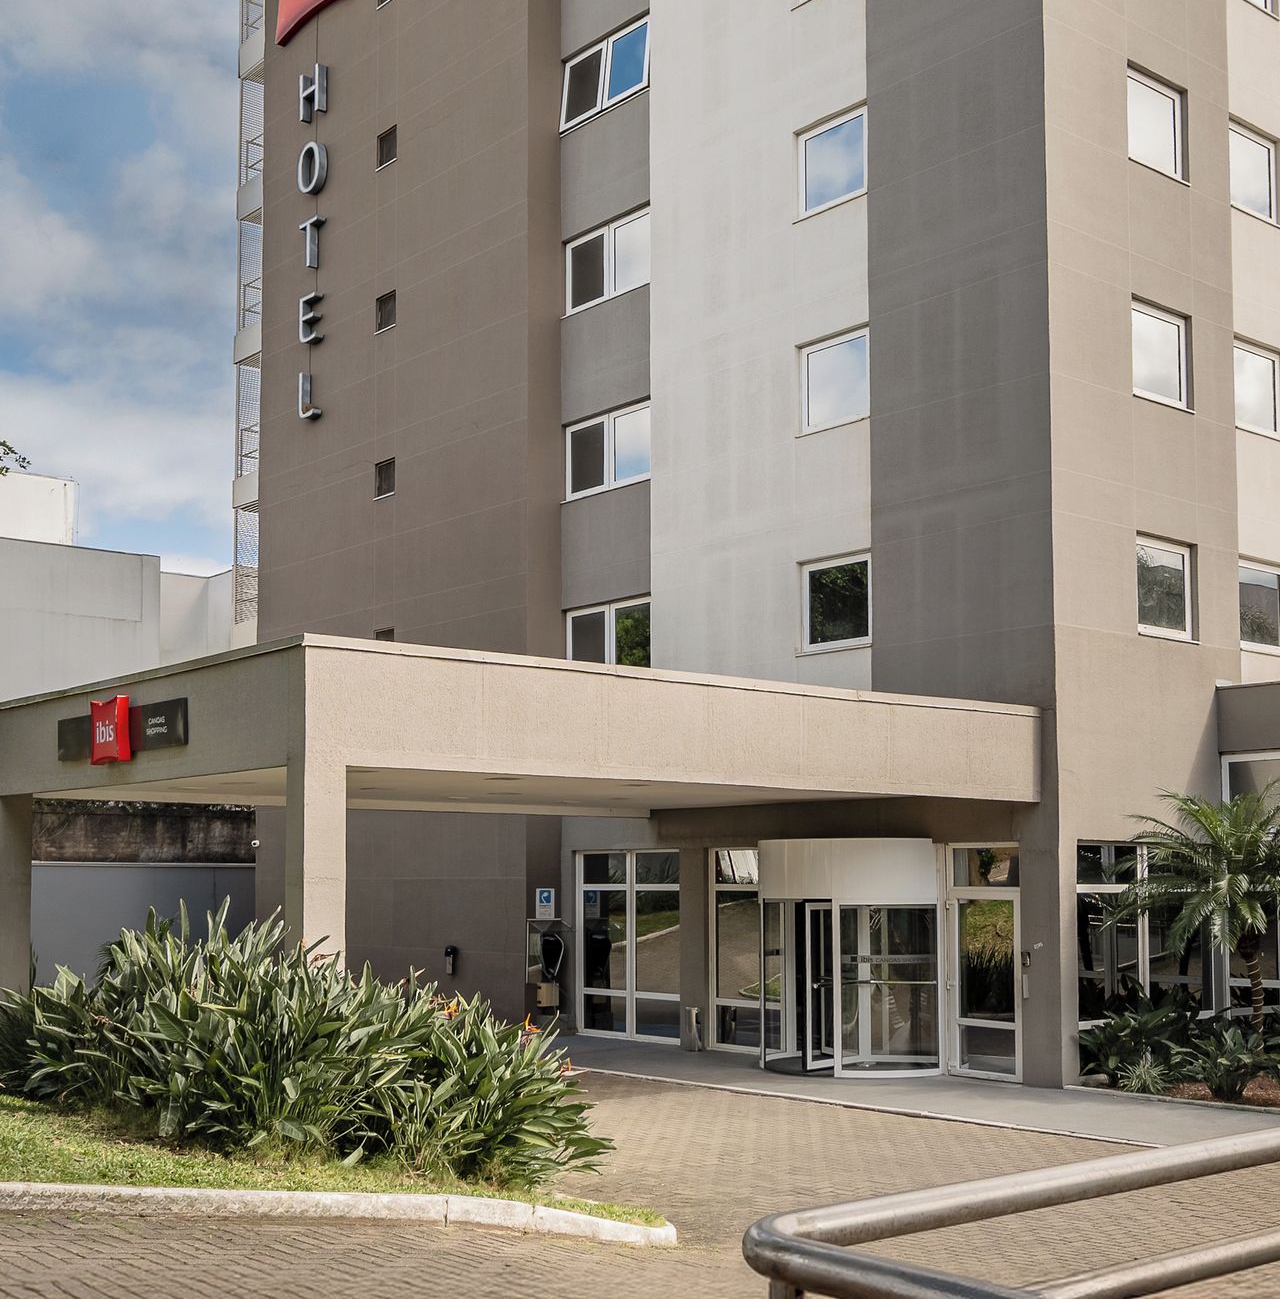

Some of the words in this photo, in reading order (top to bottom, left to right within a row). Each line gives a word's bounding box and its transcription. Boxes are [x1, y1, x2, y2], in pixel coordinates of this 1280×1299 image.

[297, 63, 328, 420] HOTEL
[148, 716, 165, 725] CANOAS
[96, 720, 114, 743] ibis
[146, 726, 167, 735] SHOPPING
[860, 955, 874, 963] ibis
